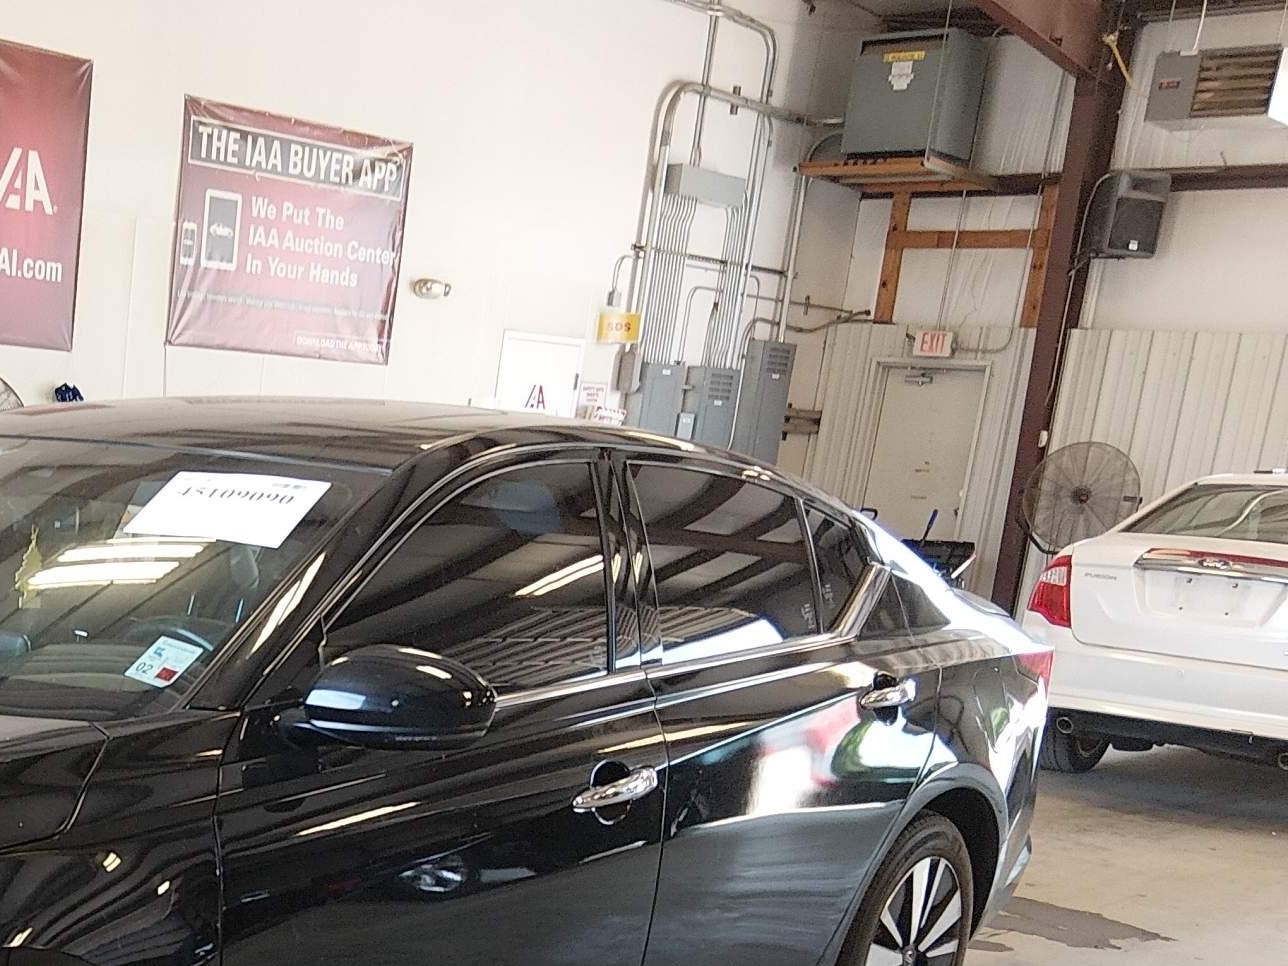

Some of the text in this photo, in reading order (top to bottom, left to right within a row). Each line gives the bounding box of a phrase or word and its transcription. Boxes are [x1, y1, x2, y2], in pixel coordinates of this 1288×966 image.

[198, 125, 398, 193] THE IAA BUYER APP
[250, 196, 345, 231] We Put The
[248, 225, 395, 266] IAA Auction Center
[246, 253, 358, 288] In Your Hands
[920, 332, 947, 352] EXIT
